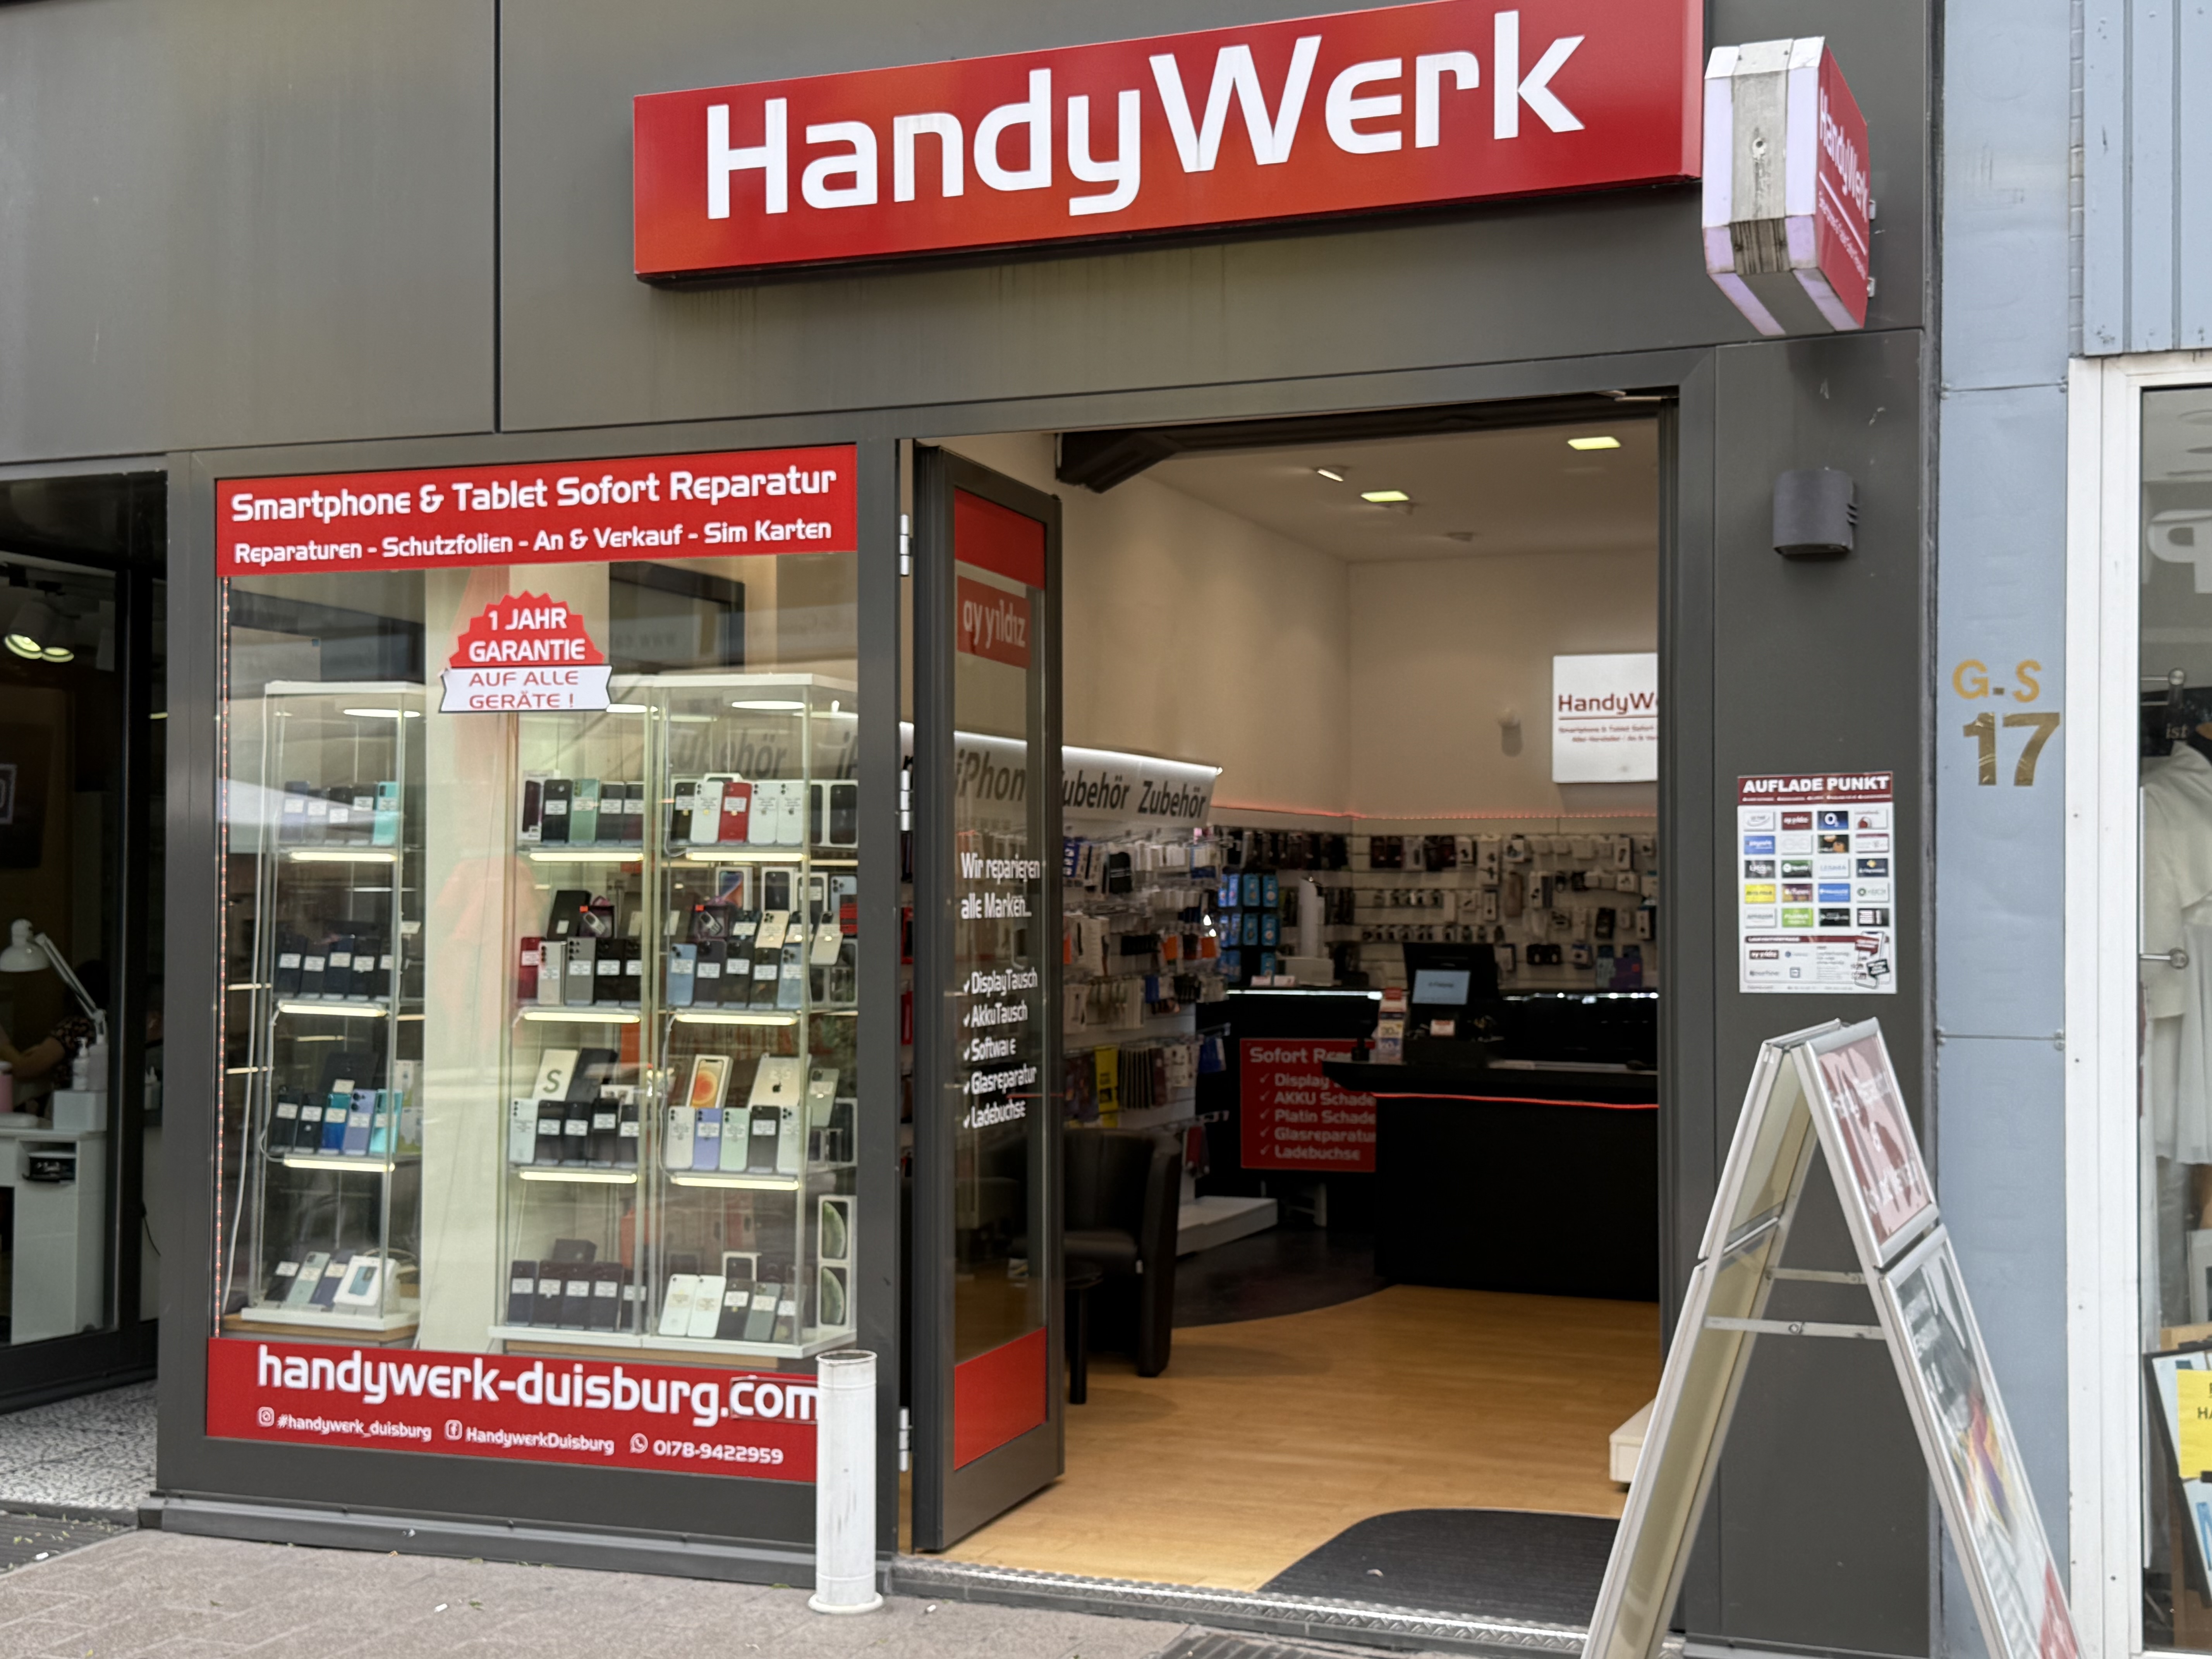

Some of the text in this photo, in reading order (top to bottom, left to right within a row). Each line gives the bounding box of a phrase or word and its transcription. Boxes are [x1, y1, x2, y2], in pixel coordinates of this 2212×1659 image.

[707, 9, 1585, 219] HandyWerk
[232, 465, 836, 524] Smartphone & Tablet Sofort Reparatur
[235, 541, 362, 567] Reparaturen
[382, 533, 512, 557] Schutzfolien
[534, 531, 563, 551] An
[570, 528, 589, 550] &
[593, 524, 683, 548] Verkauf
[704, 522, 747, 543] Sim
[755, 518, 831, 541] Karten
[489, 608, 567, 630] 1 JAHR
[963, 600, 983, 646] ay
[469, 639, 585, 662] GARANTIE
[469, 670, 578, 687] AUF ALLE
[469, 691, 560, 709] GERÄTE
[1558, 692, 1657, 715] HandyW
[1963, 712, 2060, 787] 17
[1063, 770, 1207, 819] ubehör Zubehör
[1743, 776, 1889, 793] AUFLADE PUNKT
[960, 852, 983, 879] Wir
[961, 893, 982, 919] alle
[971, 1037, 1016, 1061] Software
[1250, 1047, 1307, 1063] Sofort
[971, 1065, 1037, 1095] Glasreparatur
[1275, 1073, 1329, 1090] Display
[1274, 1092, 1316, 1105] AKKU
[971, 1100, 1026, 1129] Ladebuchse
[1274, 1146, 1360, 1161] Ladebuchse
[258, 1345, 816, 1427] handywerk-duisburg.com
[466, 1427, 615, 1456] HandywerkDuisburg
[653, 1440, 784, 1465] 0178-9422959
